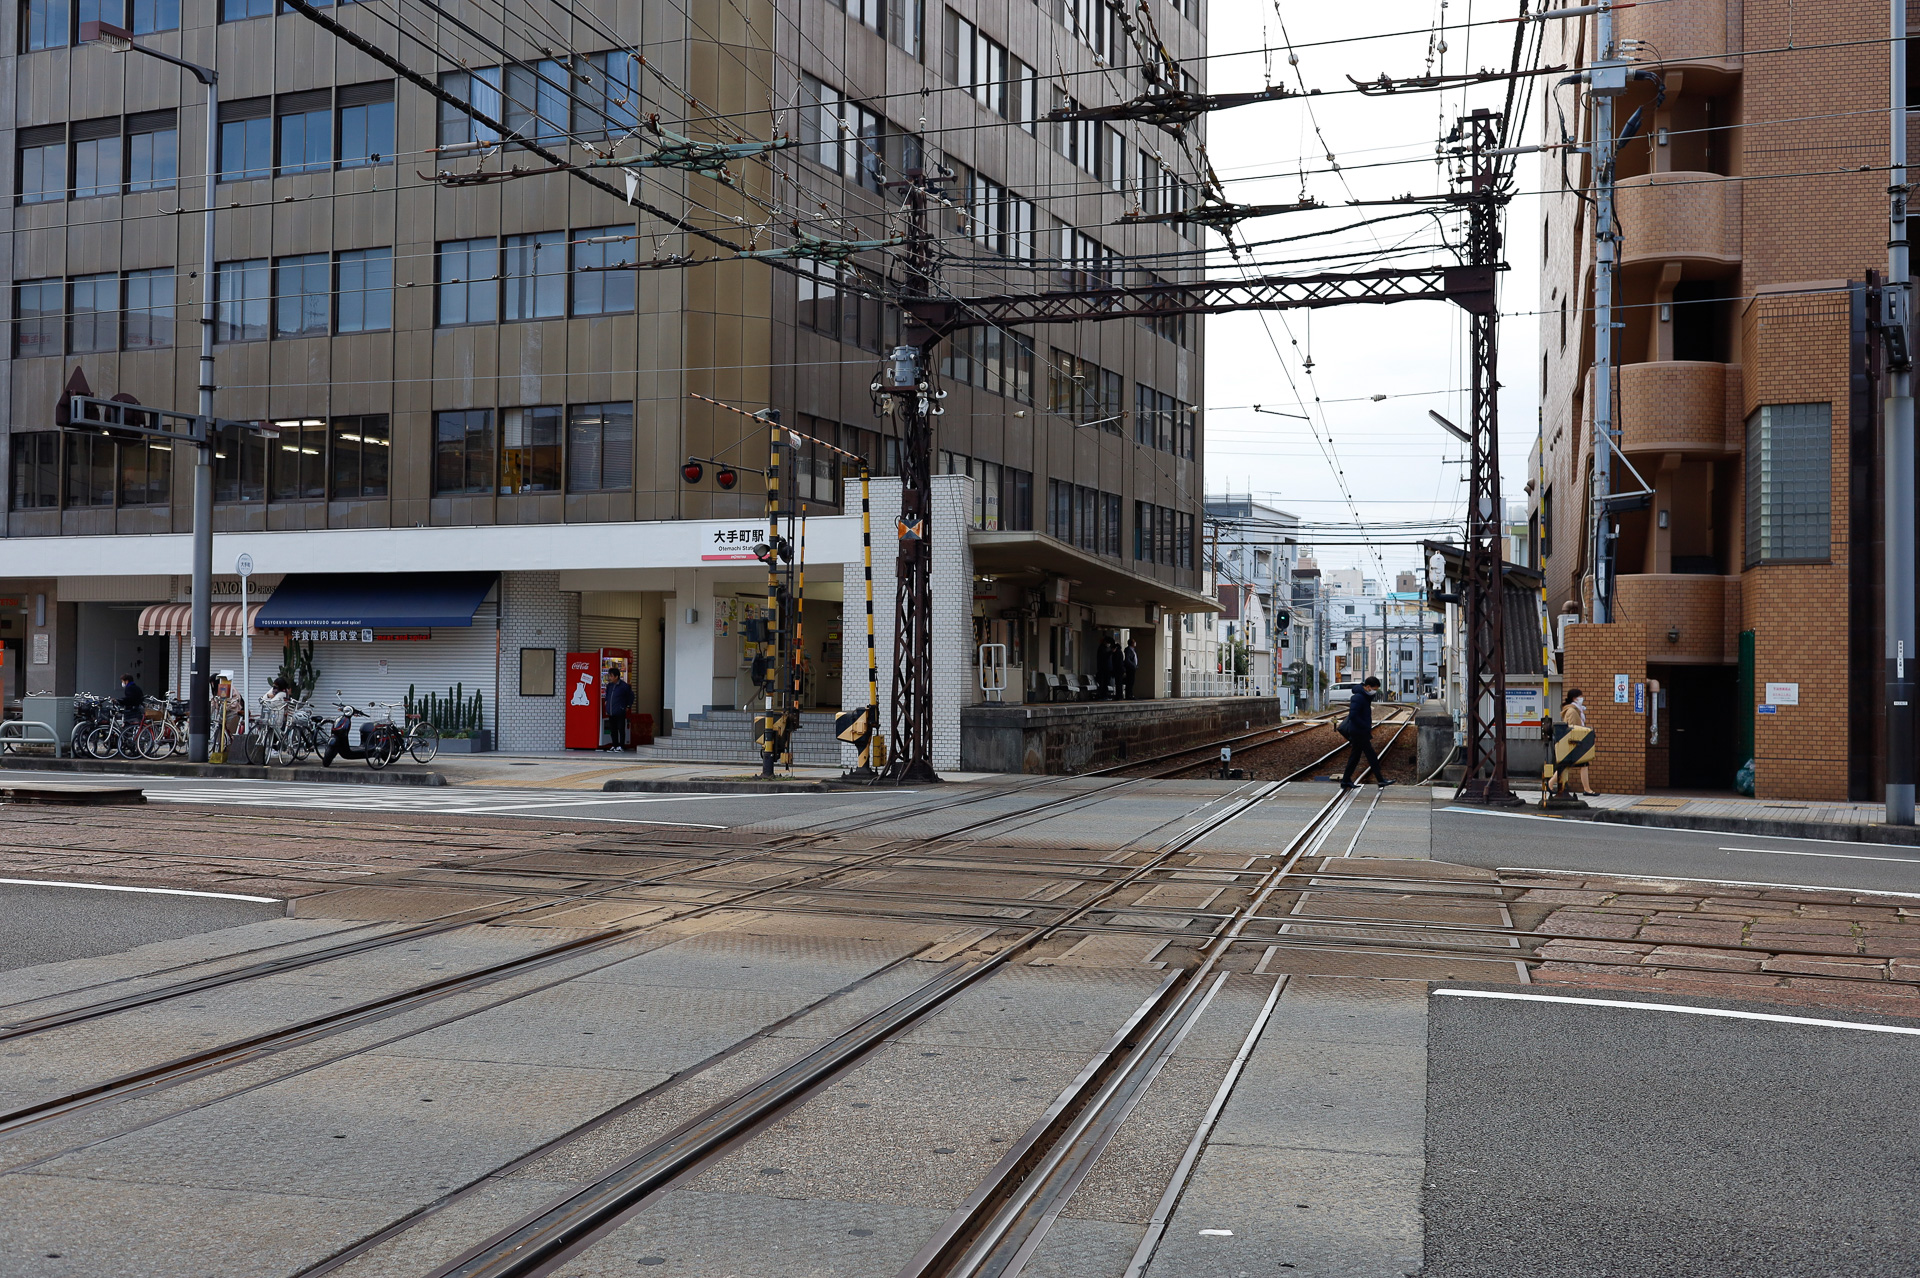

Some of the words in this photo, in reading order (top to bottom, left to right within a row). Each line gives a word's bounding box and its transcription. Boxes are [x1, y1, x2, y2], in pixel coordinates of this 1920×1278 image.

[714, 529, 764, 543] 大手町駅
[256, 586, 278, 594] CROS
[0, 598, 19, 606] ETSU
[292, 630, 358, 641] 洋食屋肉銀食堂
